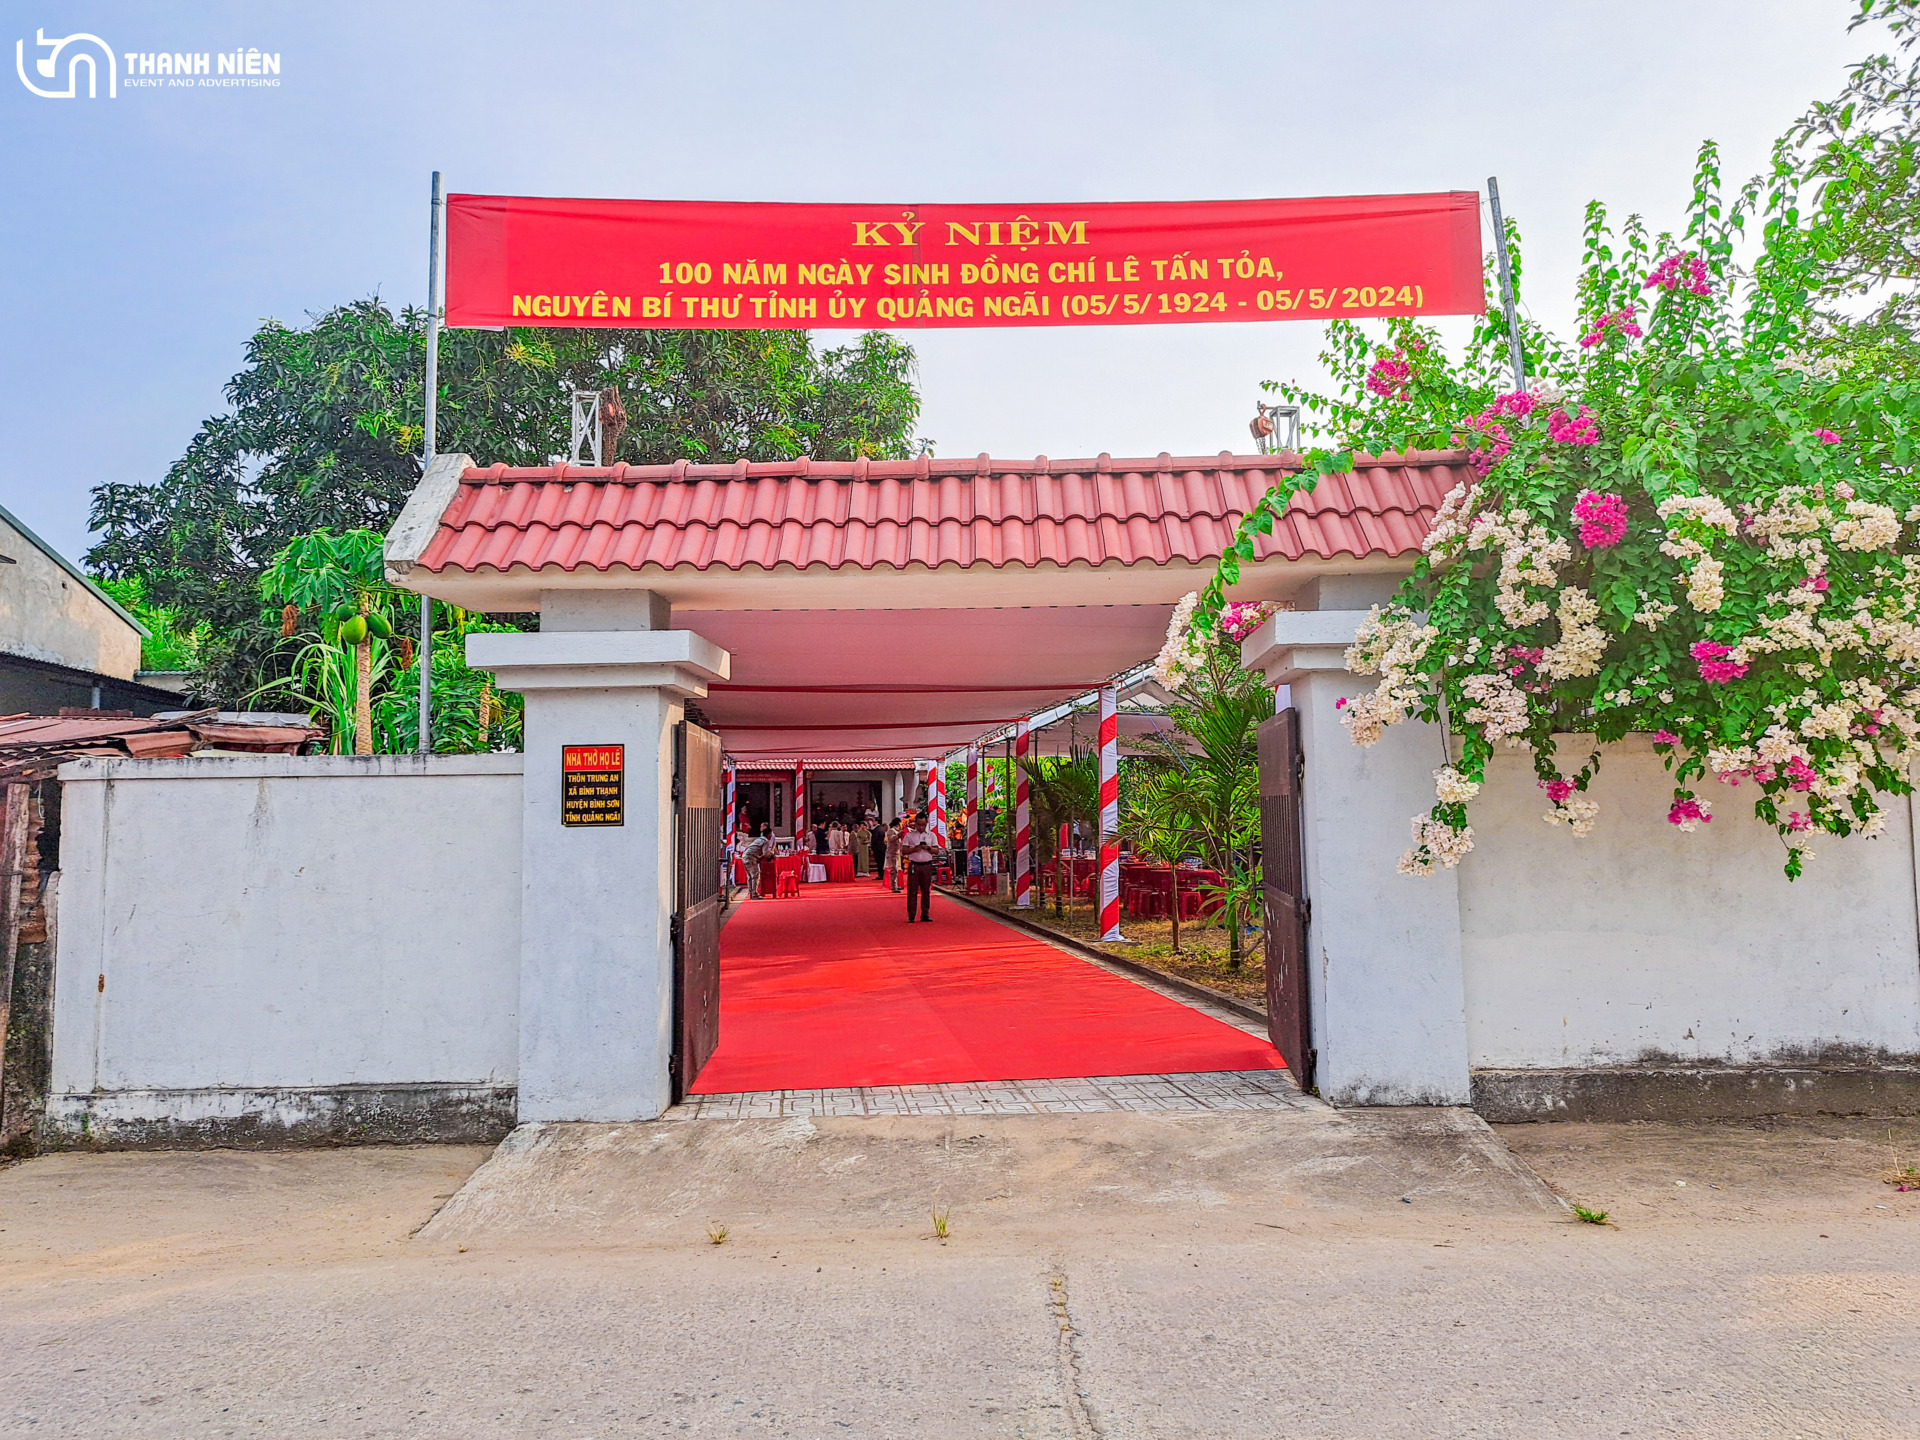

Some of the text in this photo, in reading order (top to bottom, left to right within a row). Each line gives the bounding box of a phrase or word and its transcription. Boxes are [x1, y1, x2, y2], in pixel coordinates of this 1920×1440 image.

[851, 211, 1090, 252] KỶ NIỆM
[660, 249, 1284, 286] 100 NĂM NGÀY SINH ĐỒNG CHÍ LÊ TẤN TỎA,
[512, 289, 632, 318] NGUYÊN
[642, 290, 673, 318] BÍ
[682, 293, 744, 319] THƯ
[750, 289, 817, 319] TỈNH
[828, 289, 868, 319] ỦY
[876, 288, 975, 322] QUẢNG
[983, 288, 1050, 318] NGÃI
[566, 749, 581, 766] NHÀ
[599, 752, 610, 769] HỌ
[567, 773, 619, 782] THÔN TRUNG AN
[568, 785, 618, 796] XÃ BÌNH THẠNH
[566, 798, 588, 810] HUYỆN
[589, 798, 605, 808] BÌNH
[565, 810, 620, 823] TỈNH QUẢNG NGÃI
